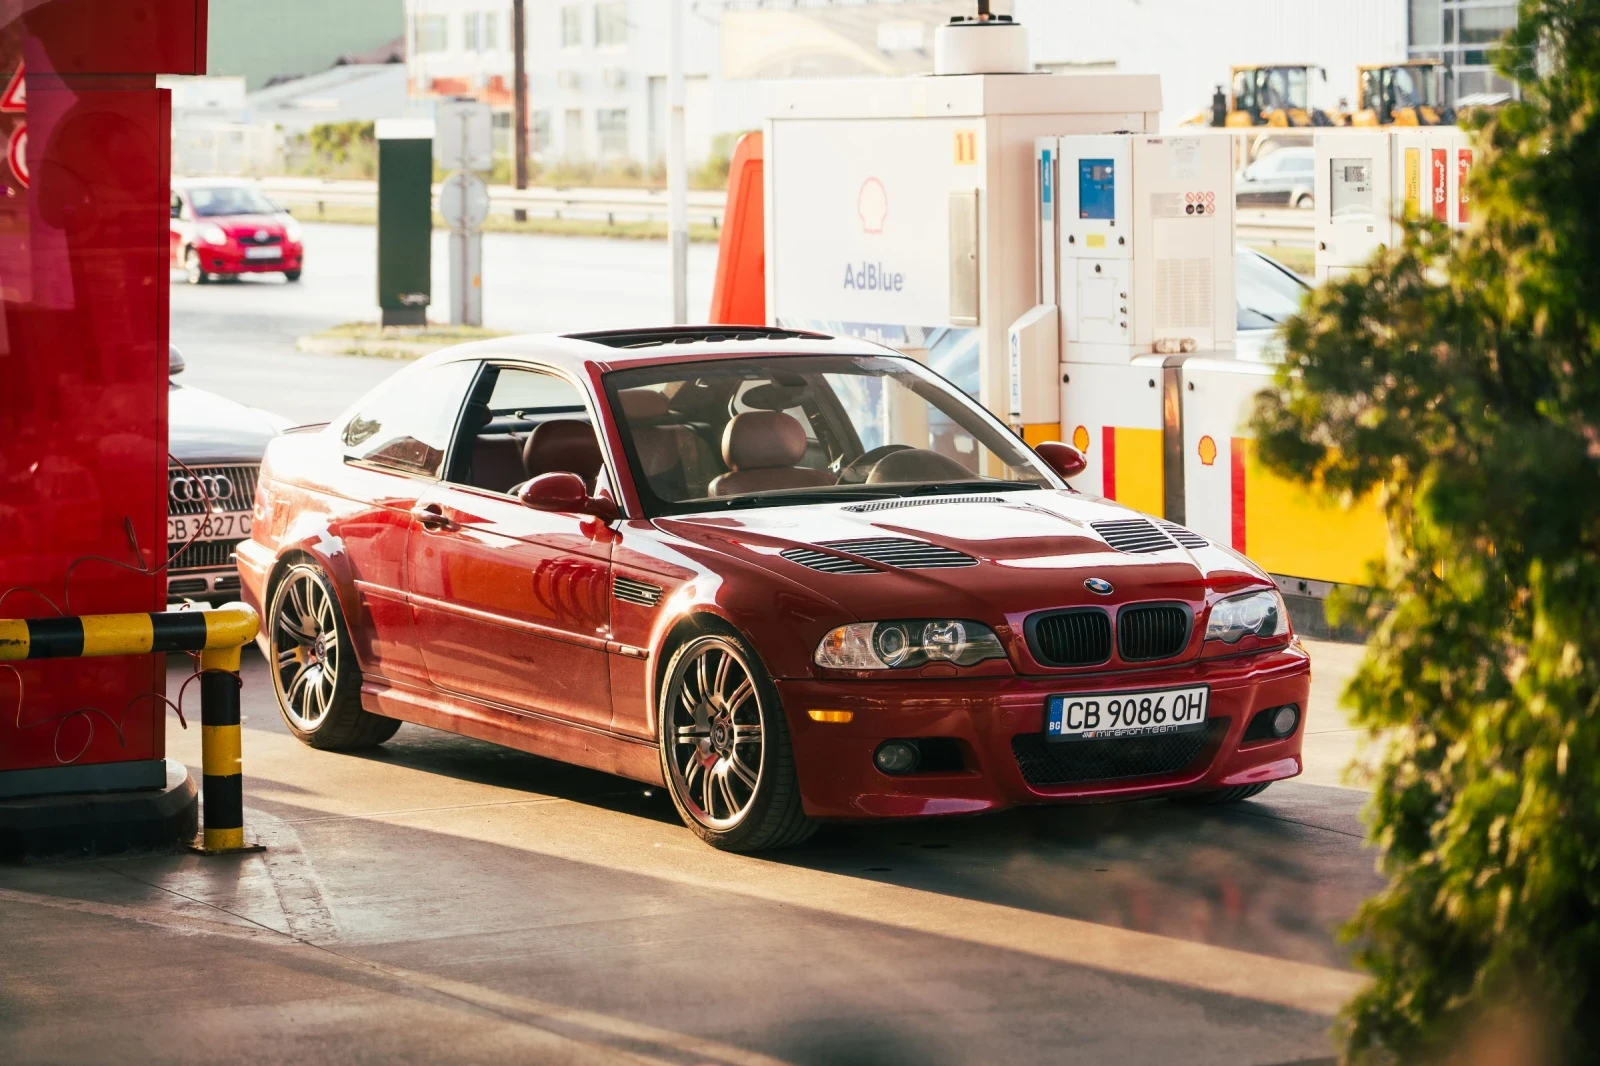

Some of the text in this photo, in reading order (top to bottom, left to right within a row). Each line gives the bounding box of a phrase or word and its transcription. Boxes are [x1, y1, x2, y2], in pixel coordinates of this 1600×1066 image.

[956, 132, 975, 161] 11
[843, 261, 903, 292] AdBlue
[239, 515, 253, 535] C
[1066, 692, 1204, 730] CB 9086 OH
[1048, 721, 1061, 731] BG
